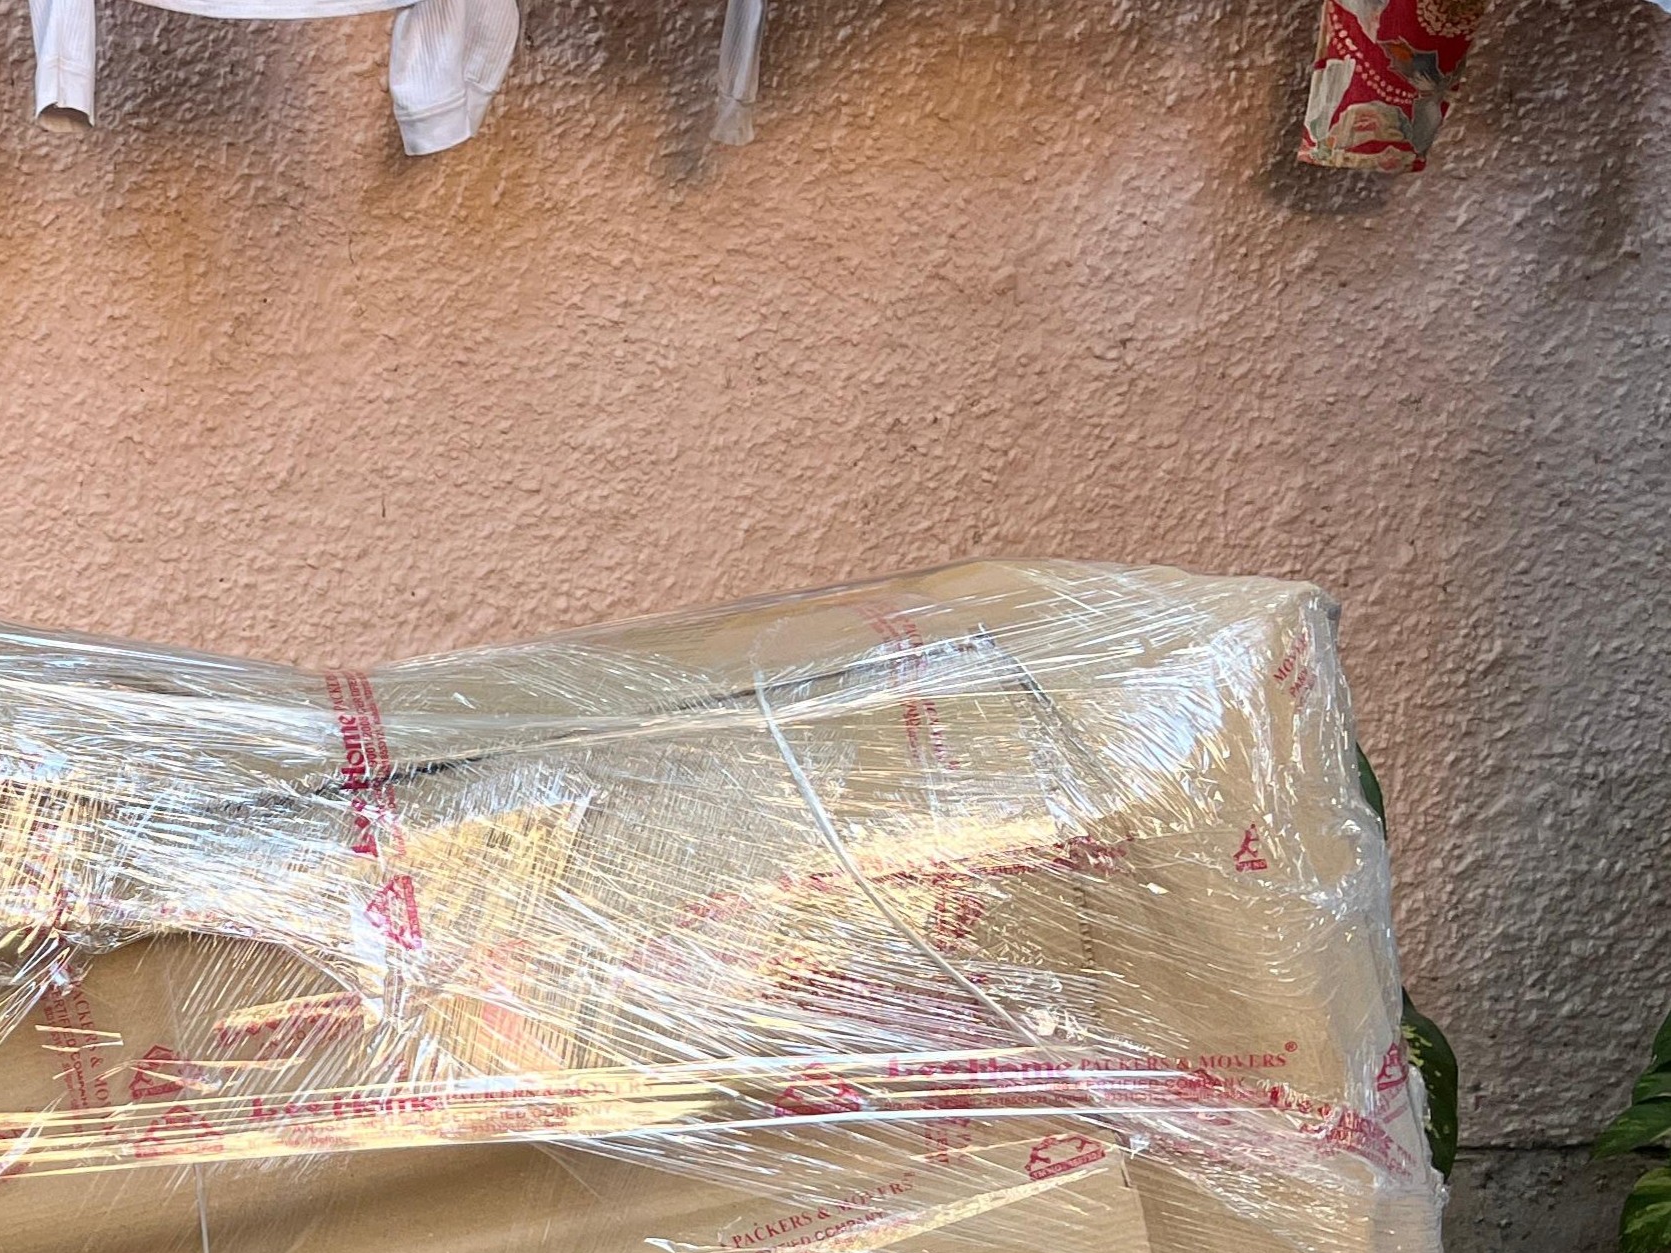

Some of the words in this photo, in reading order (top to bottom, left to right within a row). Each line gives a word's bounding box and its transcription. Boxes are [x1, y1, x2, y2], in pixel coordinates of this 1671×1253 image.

[337, 713, 370, 790] Home
[1080, 1056, 1171, 1072] PACKERS
[731, 1211, 814, 1249] PACKERS
[817, 1205, 831, 1221] &
